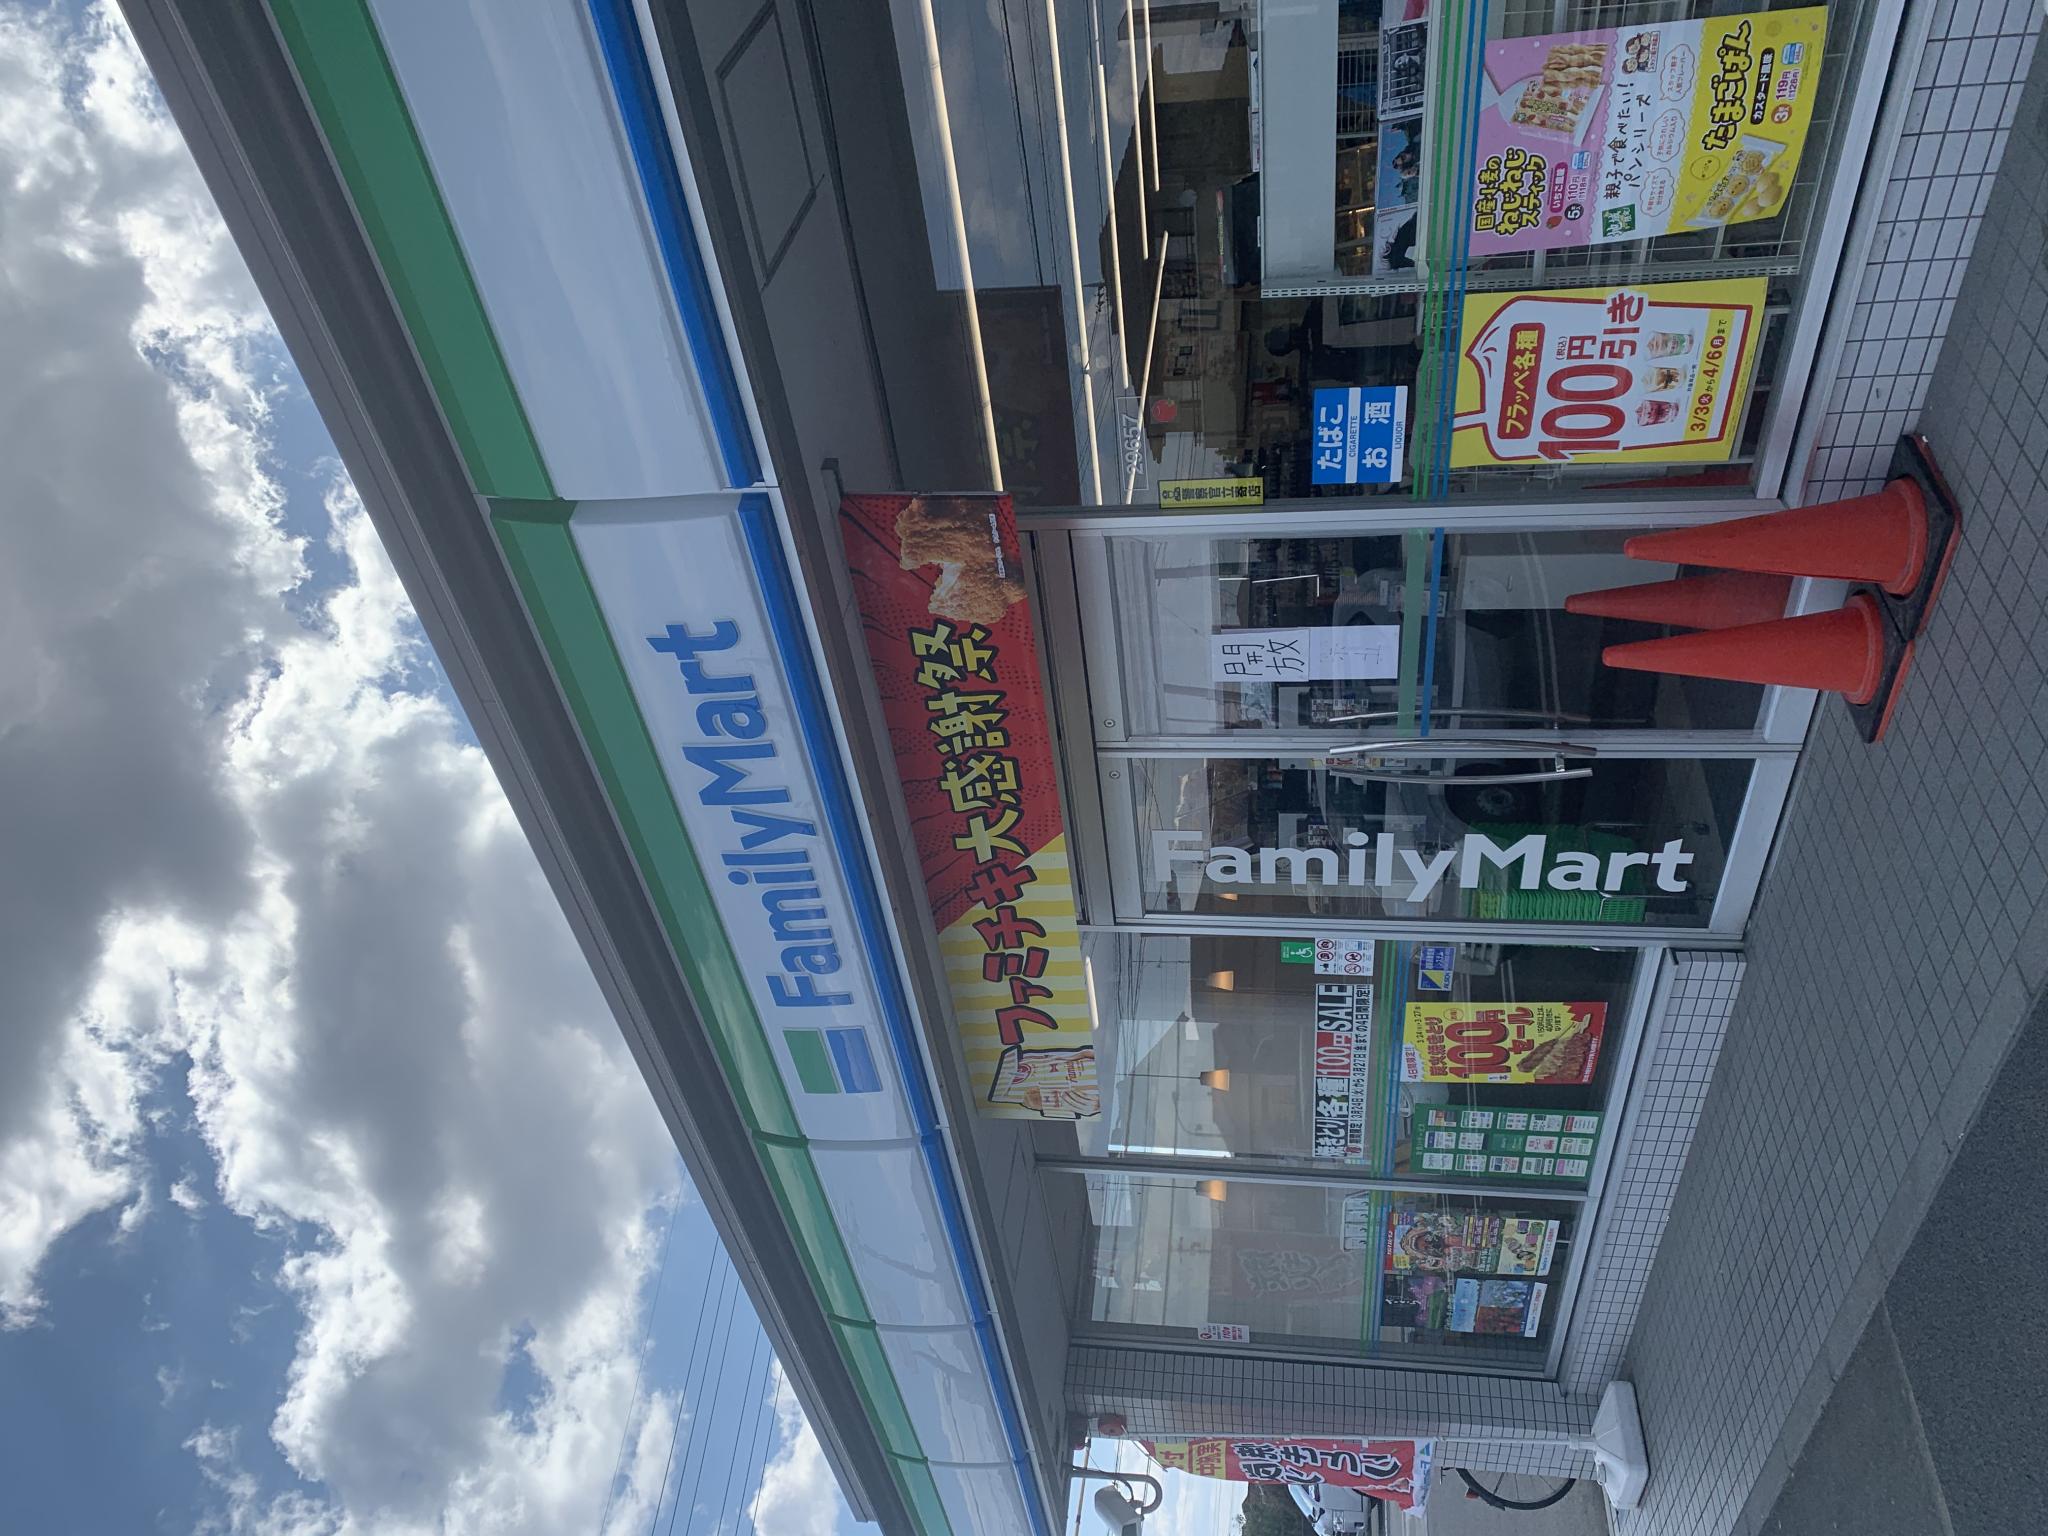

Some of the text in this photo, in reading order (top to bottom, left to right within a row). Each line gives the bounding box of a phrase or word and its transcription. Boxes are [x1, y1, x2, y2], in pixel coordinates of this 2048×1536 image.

[1701, 19, 1753, 151] たまごぱん
[1752, 52, 1773, 121] カスタード風味
[1776, 70, 1790, 101] 119円
[1603, 82, 1634, 200] 親子で食べたい!
[1624, 93, 1652, 187] パンシリーズ
[1475, 155, 1502, 232] 国産小麦の
[1498, 147, 1526, 236] ねじねじ
[1521, 154, 1546, 228] スティック
[1552, 167, 1566, 209] いちご風味
[1504, 329, 1539, 435] フラッペ各種
[1537, 364, 1634, 460] 100
[1121, 413, 1144, 475] 29657
[1316, 404, 1343, 470] たばこ
[1348, 415, 1358, 458] CIGARETTE
[1361, 402, 1391, 468] お酒
[1394, 421, 1404, 450] LIQUOR
[1222, 639, 1305, 676] 開放
[645, 619, 854, 1008] FamilyMart
[907, 618, 1058, 1046] ファミチキ大感謝祭
[1151, 829, 1695, 902] FamilyMart
[1318, 985, 1353, 1031] SALE
[1507, 1006, 1535, 1055] セール
[1317, 1032, 1352, 1075] 100円
[1445, 1021, 1512, 1079] 100
[1316, 1078, 1349, 1117] 各種
